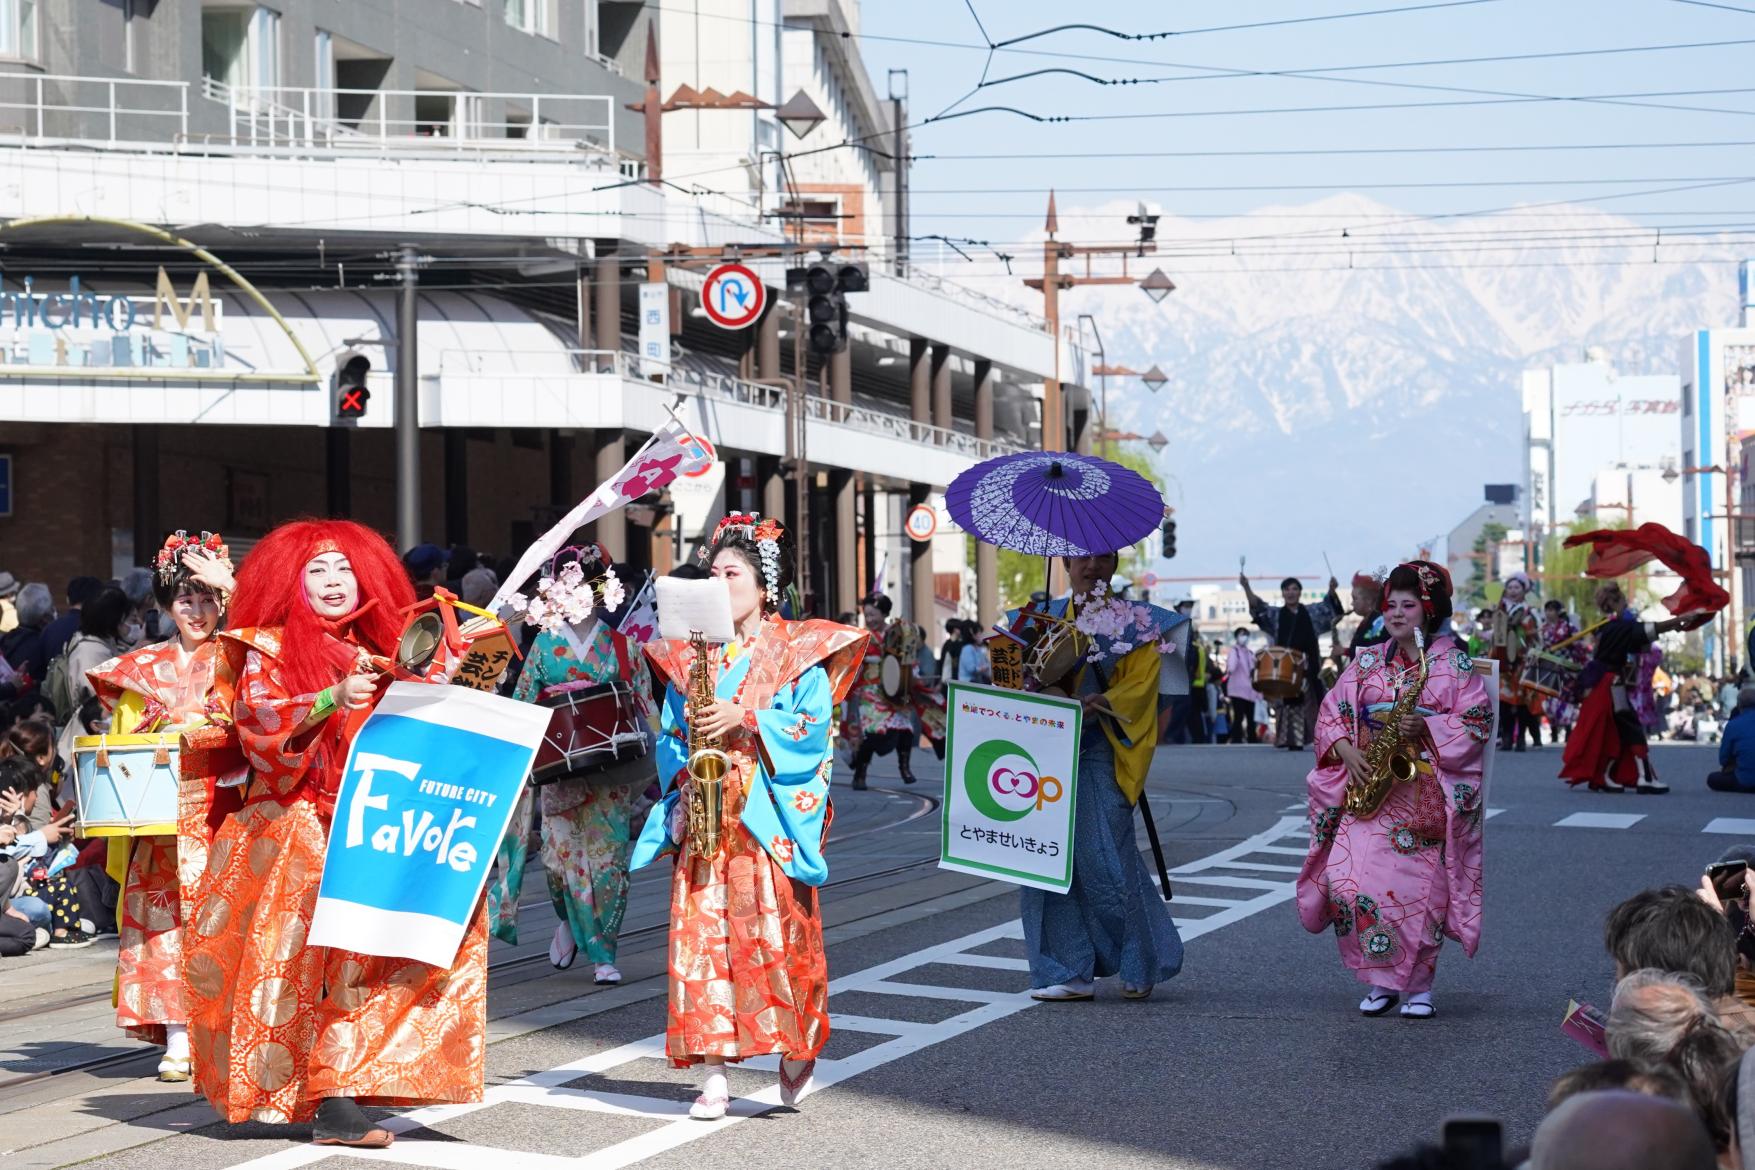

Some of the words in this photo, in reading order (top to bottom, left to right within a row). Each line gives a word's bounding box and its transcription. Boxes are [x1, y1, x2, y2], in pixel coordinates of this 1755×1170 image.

[914, 514, 930, 529] 40
[419, 779, 464, 801] FUTURE
[465, 786, 498, 807] CITY
[346, 751, 479, 872] Favore
[960, 825, 1060, 857] とやませいきょう
